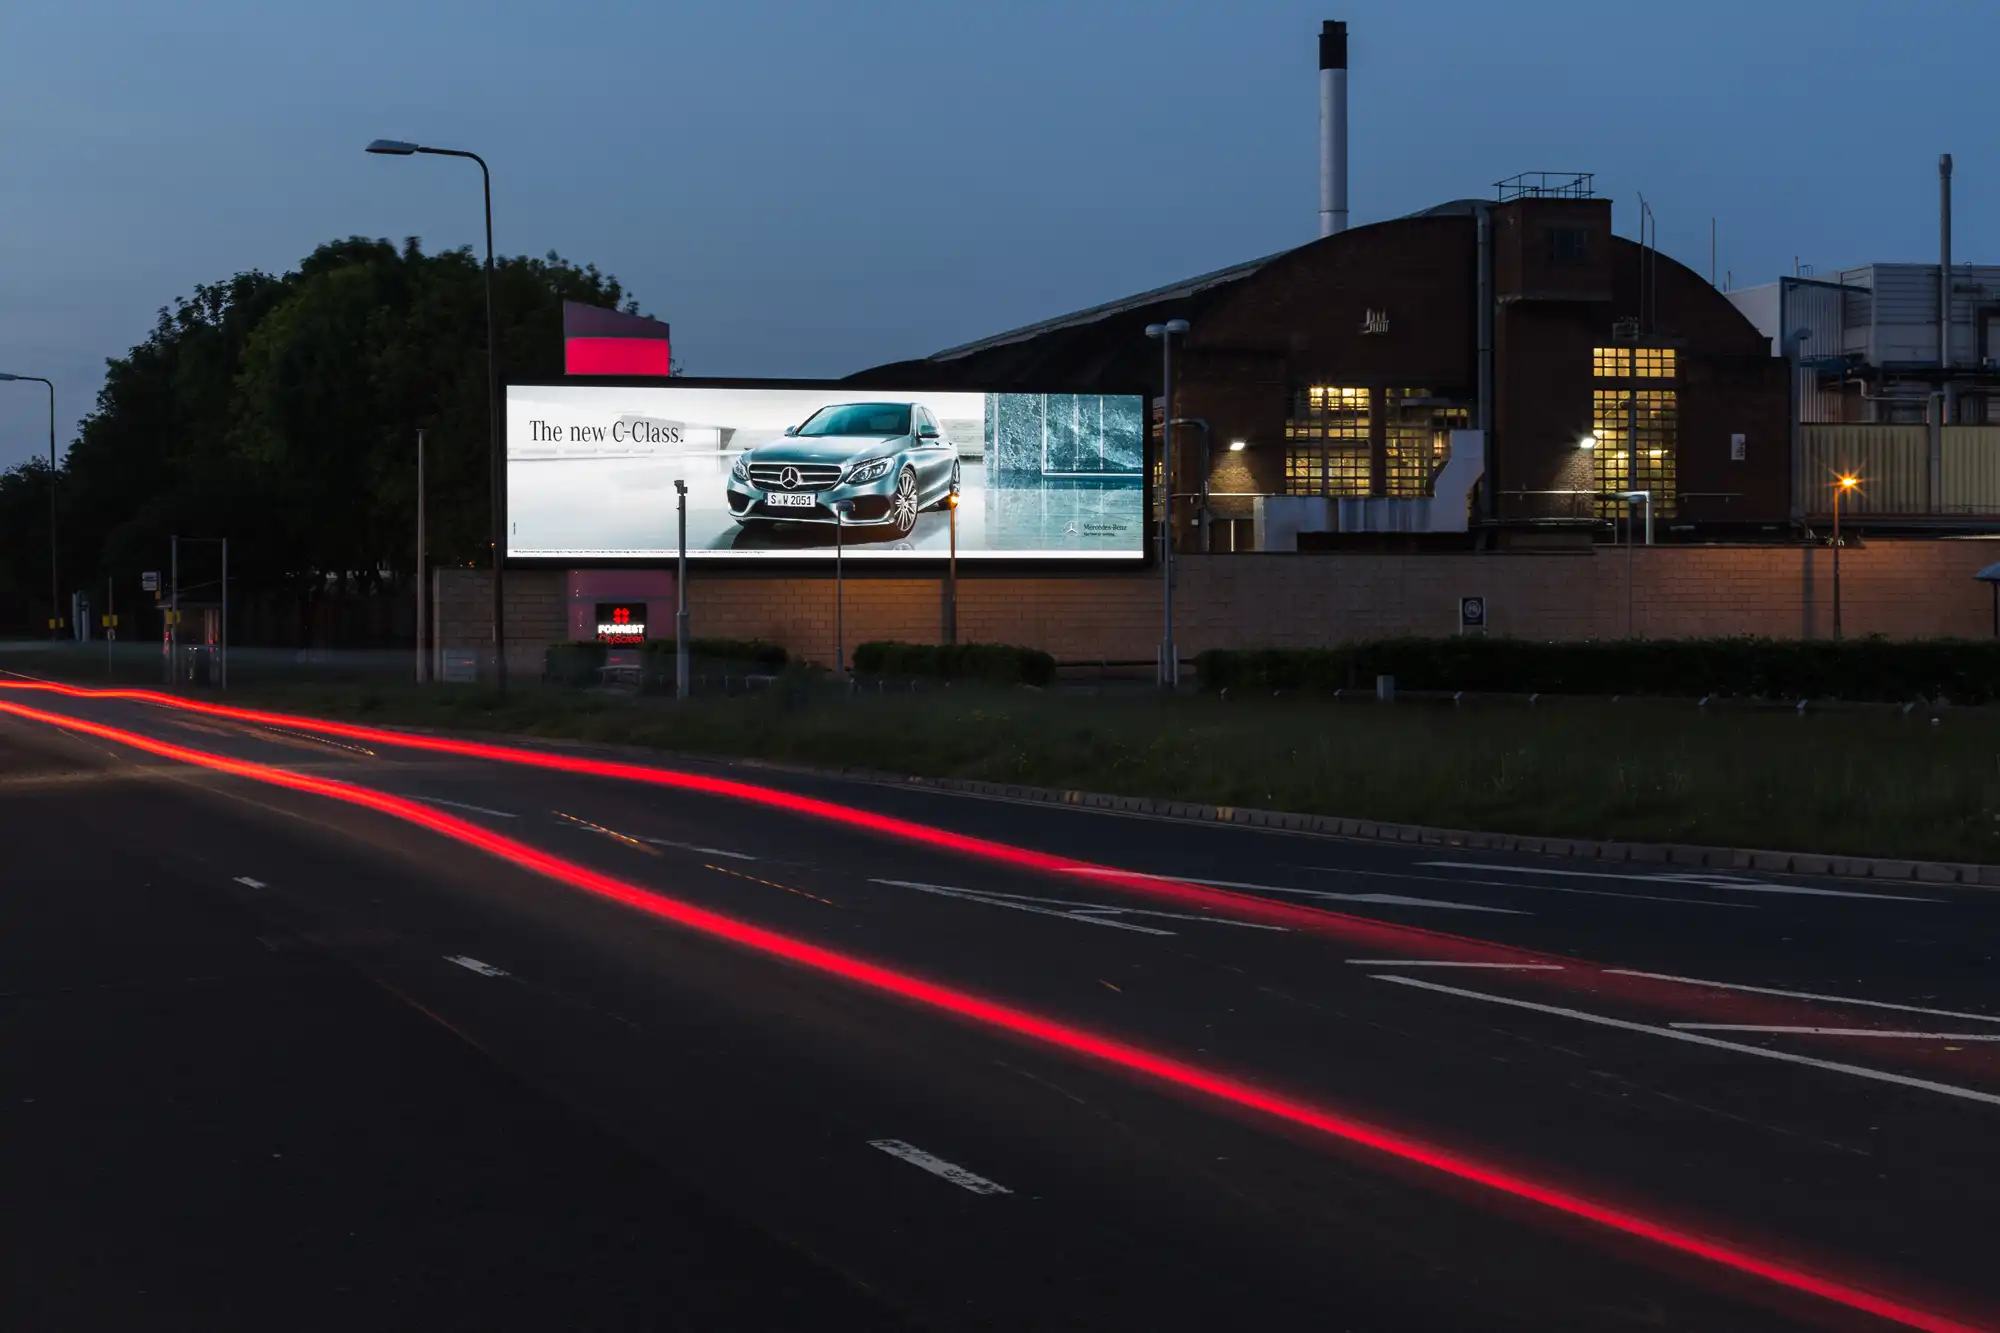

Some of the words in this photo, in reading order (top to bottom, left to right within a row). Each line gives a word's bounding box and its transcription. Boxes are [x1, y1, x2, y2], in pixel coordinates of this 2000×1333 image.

[529, 420, 563, 442] The
[570, 424, 607, 442] new
[612, 420, 684, 443] C-Class.
[790, 495, 812, 506] 2051
[598, 624, 644, 633] FORREST
